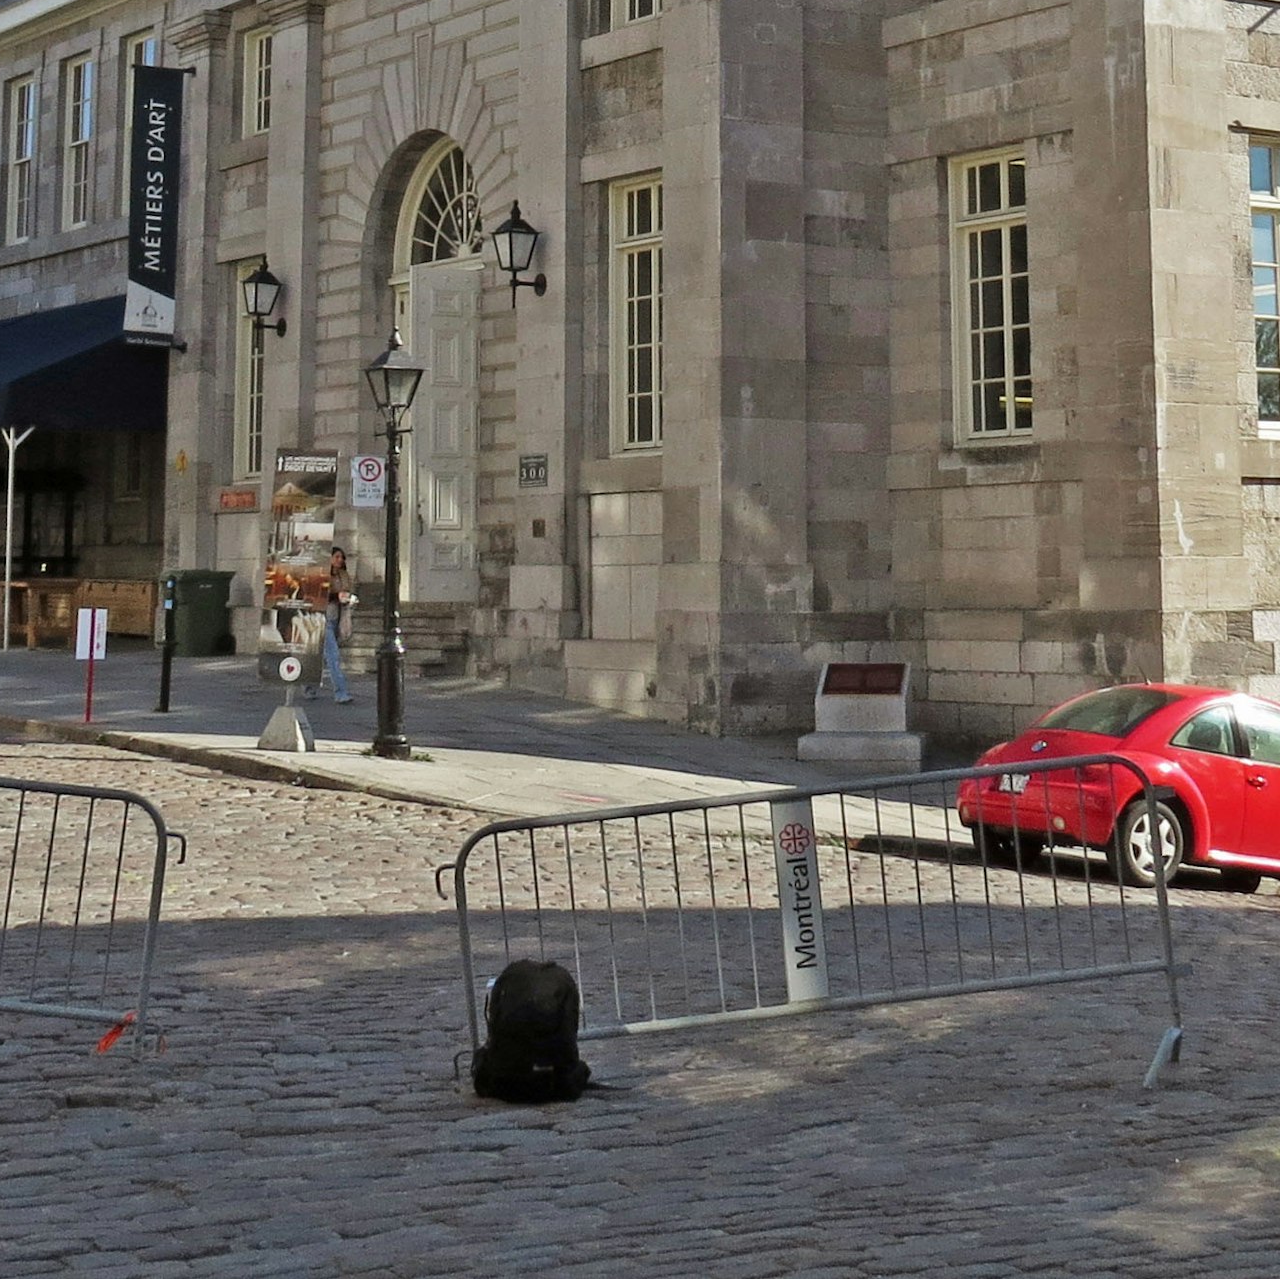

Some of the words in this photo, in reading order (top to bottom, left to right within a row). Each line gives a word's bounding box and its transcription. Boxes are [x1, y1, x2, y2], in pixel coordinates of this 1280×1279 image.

[146, 98, 167, 163] D'ART
[140, 170, 164, 272] MÉTIERS
[520, 466, 545, 480] 300
[786, 856, 818, 969] Montréal
